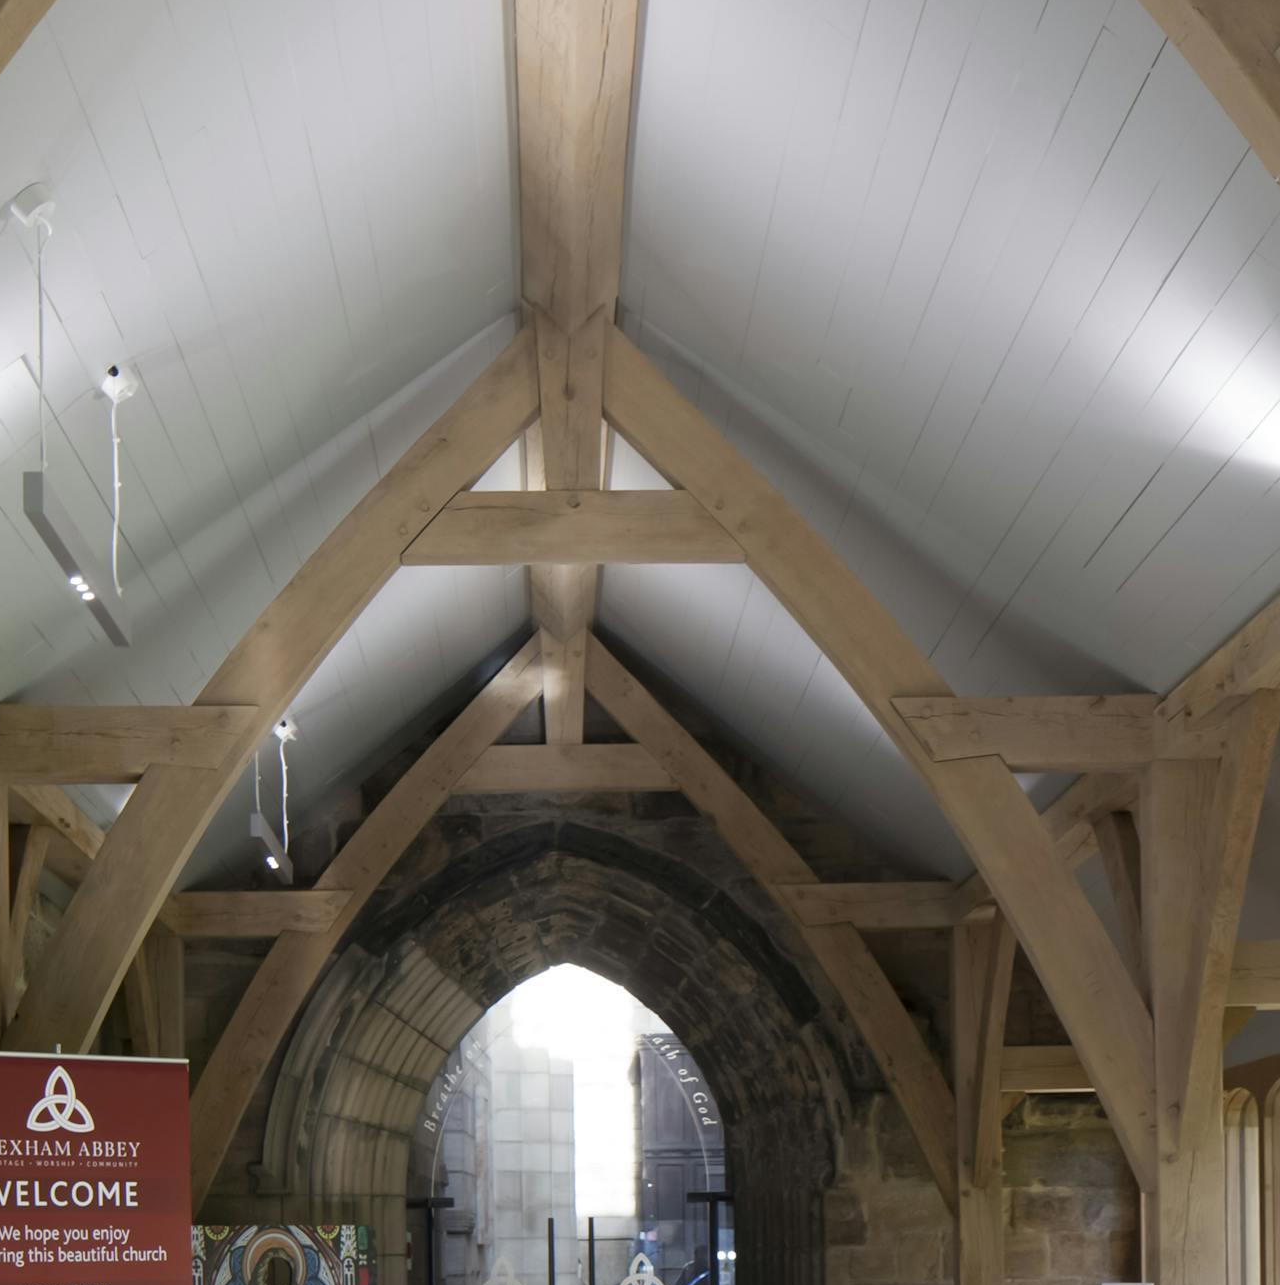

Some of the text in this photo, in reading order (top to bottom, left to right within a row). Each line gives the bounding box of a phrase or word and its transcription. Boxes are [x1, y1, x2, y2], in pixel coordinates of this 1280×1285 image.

[423, 1065, 463, 1132] Breathe
[465, 1041, 481, 1059] on
[678, 1068, 699, 1082] of
[693, 1092, 718, 1125] God
[78, 1140, 141, 1158] ABBEY
[86, 1160, 138, 1168] COMMUNITY
[24, 1225, 59, 1245] hope
[63, 1228, 88, 1245] you
[92, 1225, 130, 1245] enjoy
[28, 1246, 54, 1263] this
[58, 1246, 119, 1263] beautiful
[122, 1245, 167, 1262] church
